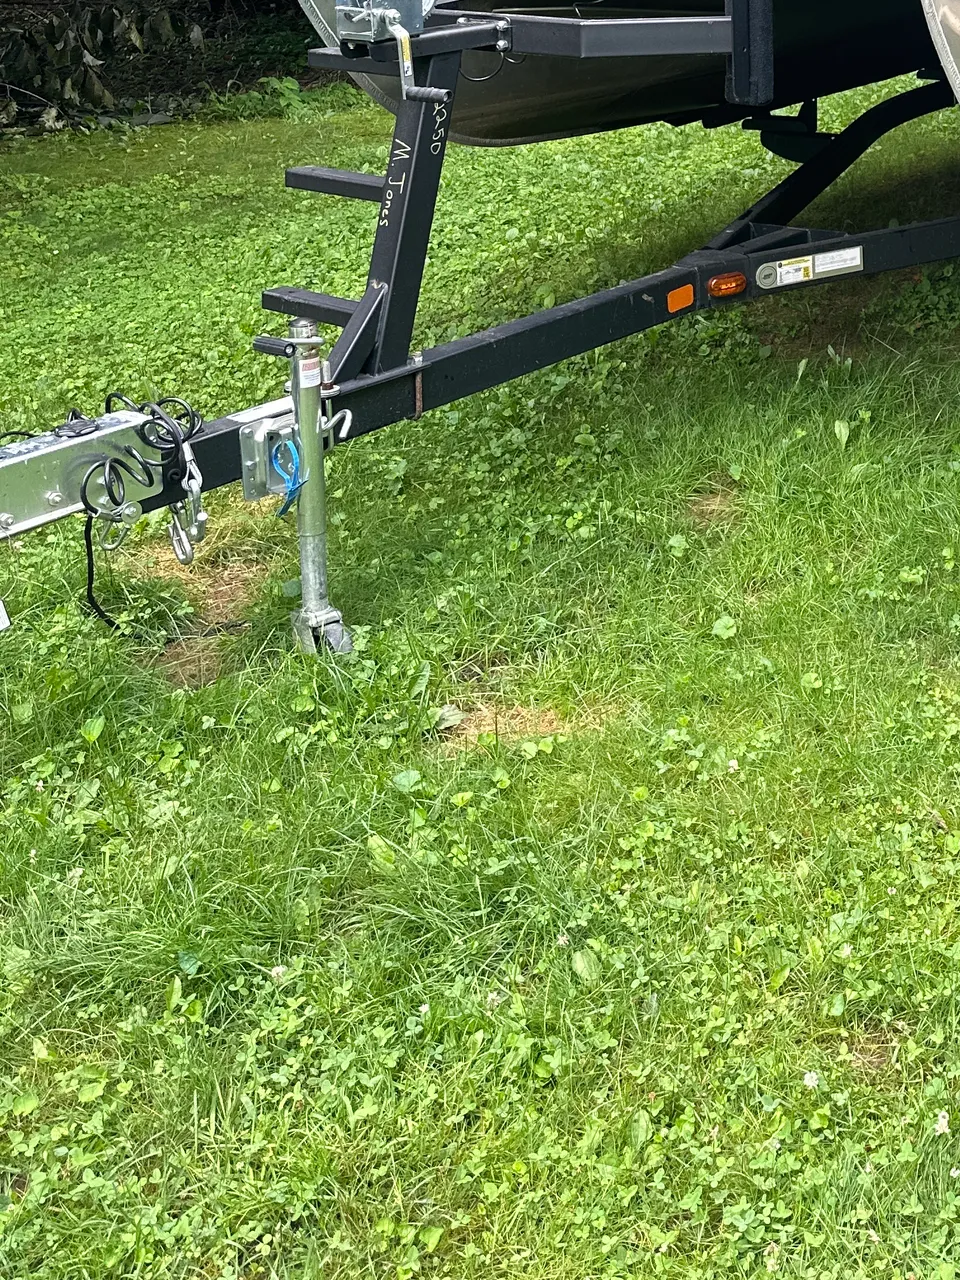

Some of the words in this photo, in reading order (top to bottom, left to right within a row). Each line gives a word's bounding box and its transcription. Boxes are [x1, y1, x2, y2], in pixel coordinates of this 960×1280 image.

[391, 138, 412, 167] M.
[430, 102, 447, 155] 2250
[379, 171, 406, 227] Jones
